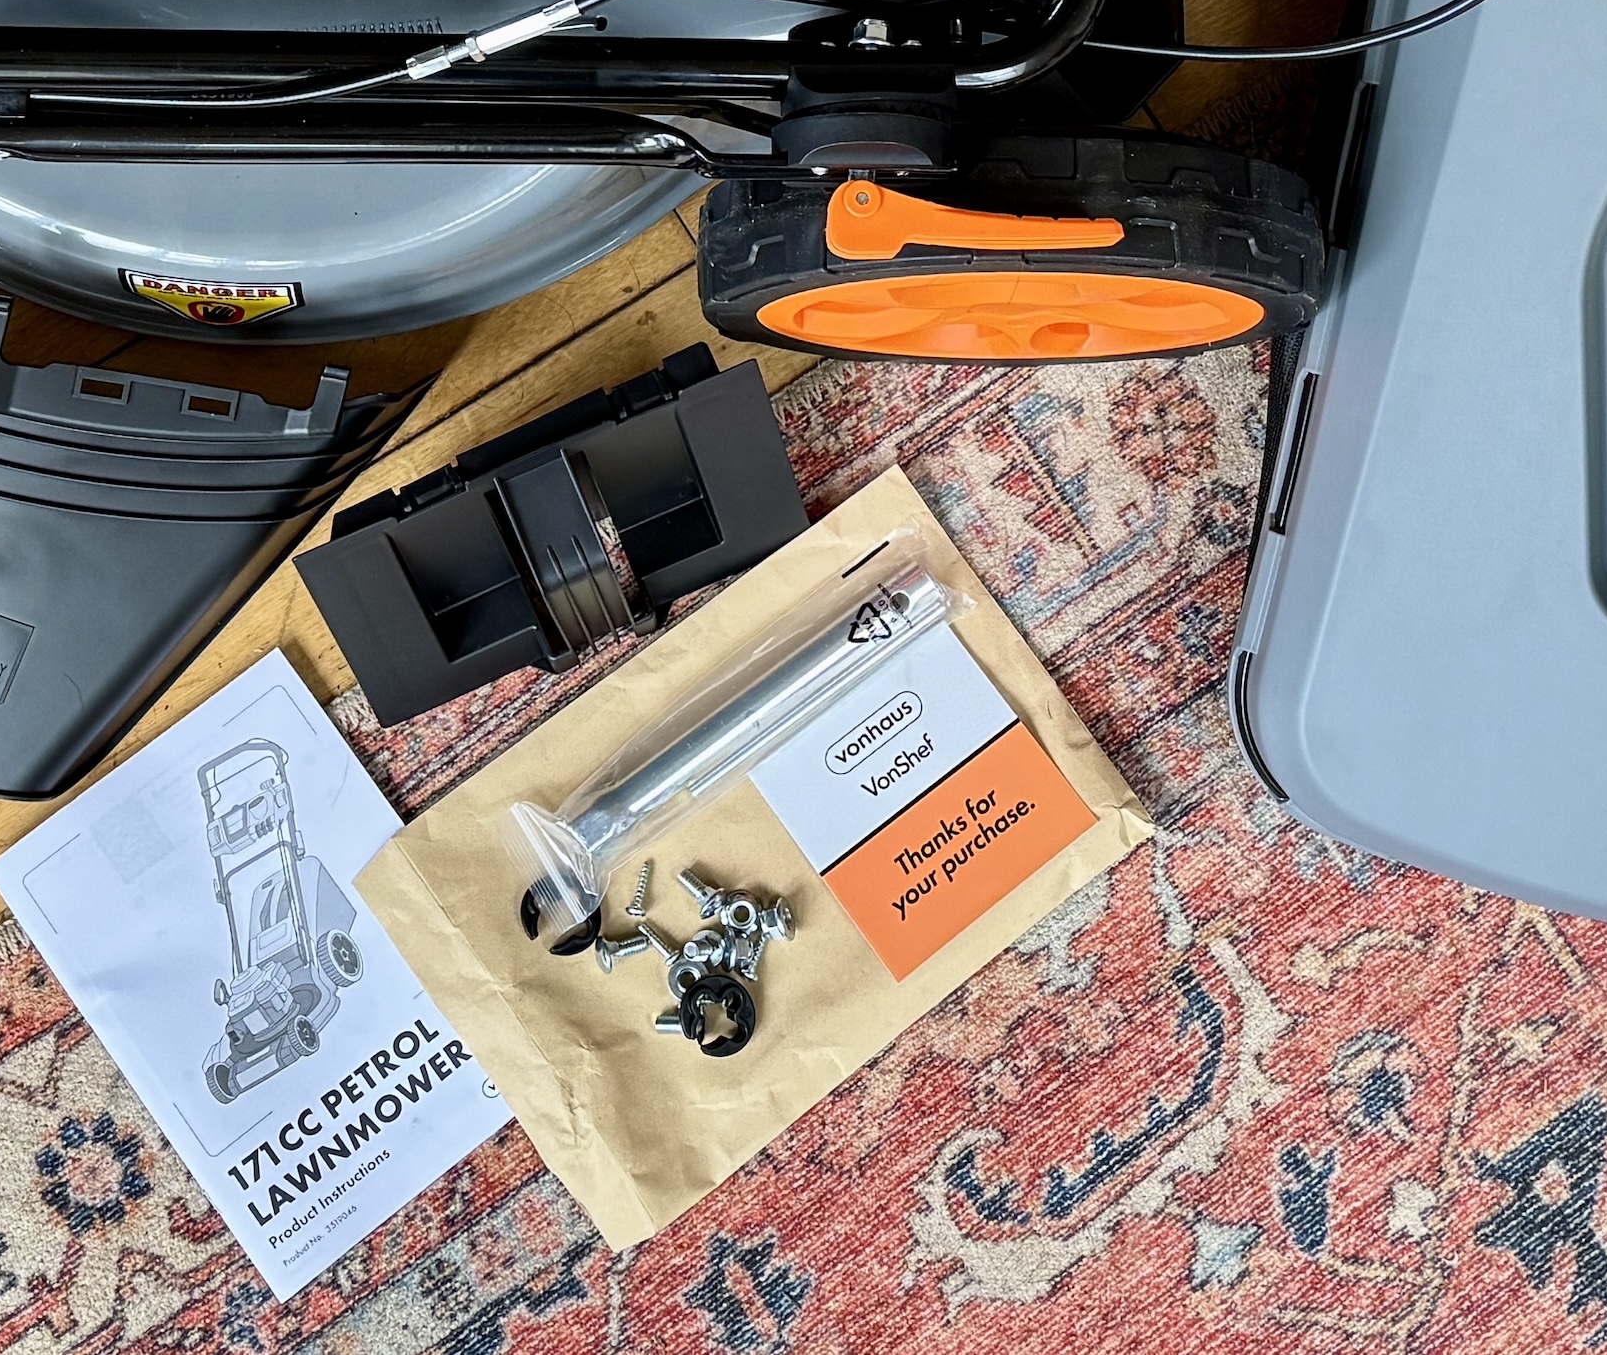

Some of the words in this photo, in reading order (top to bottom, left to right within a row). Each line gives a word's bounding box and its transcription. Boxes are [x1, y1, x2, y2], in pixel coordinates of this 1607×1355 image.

[142, 279, 278, 297] DANGER
[834, 701, 913, 763] vonhaus
[860, 732, 934, 797] VonShef
[891, 870, 938, 921] your
[941, 801, 1036, 883] purchase.
[894, 815, 968, 875] Thanks
[965, 789, 997, 822] for
[320, 1019, 440, 1120] PETROL
[246, 1039, 474, 1227] LAWNMOWER
[268, 1205, 319, 1249] Product
[317, 1149, 391, 1210] Instructions
